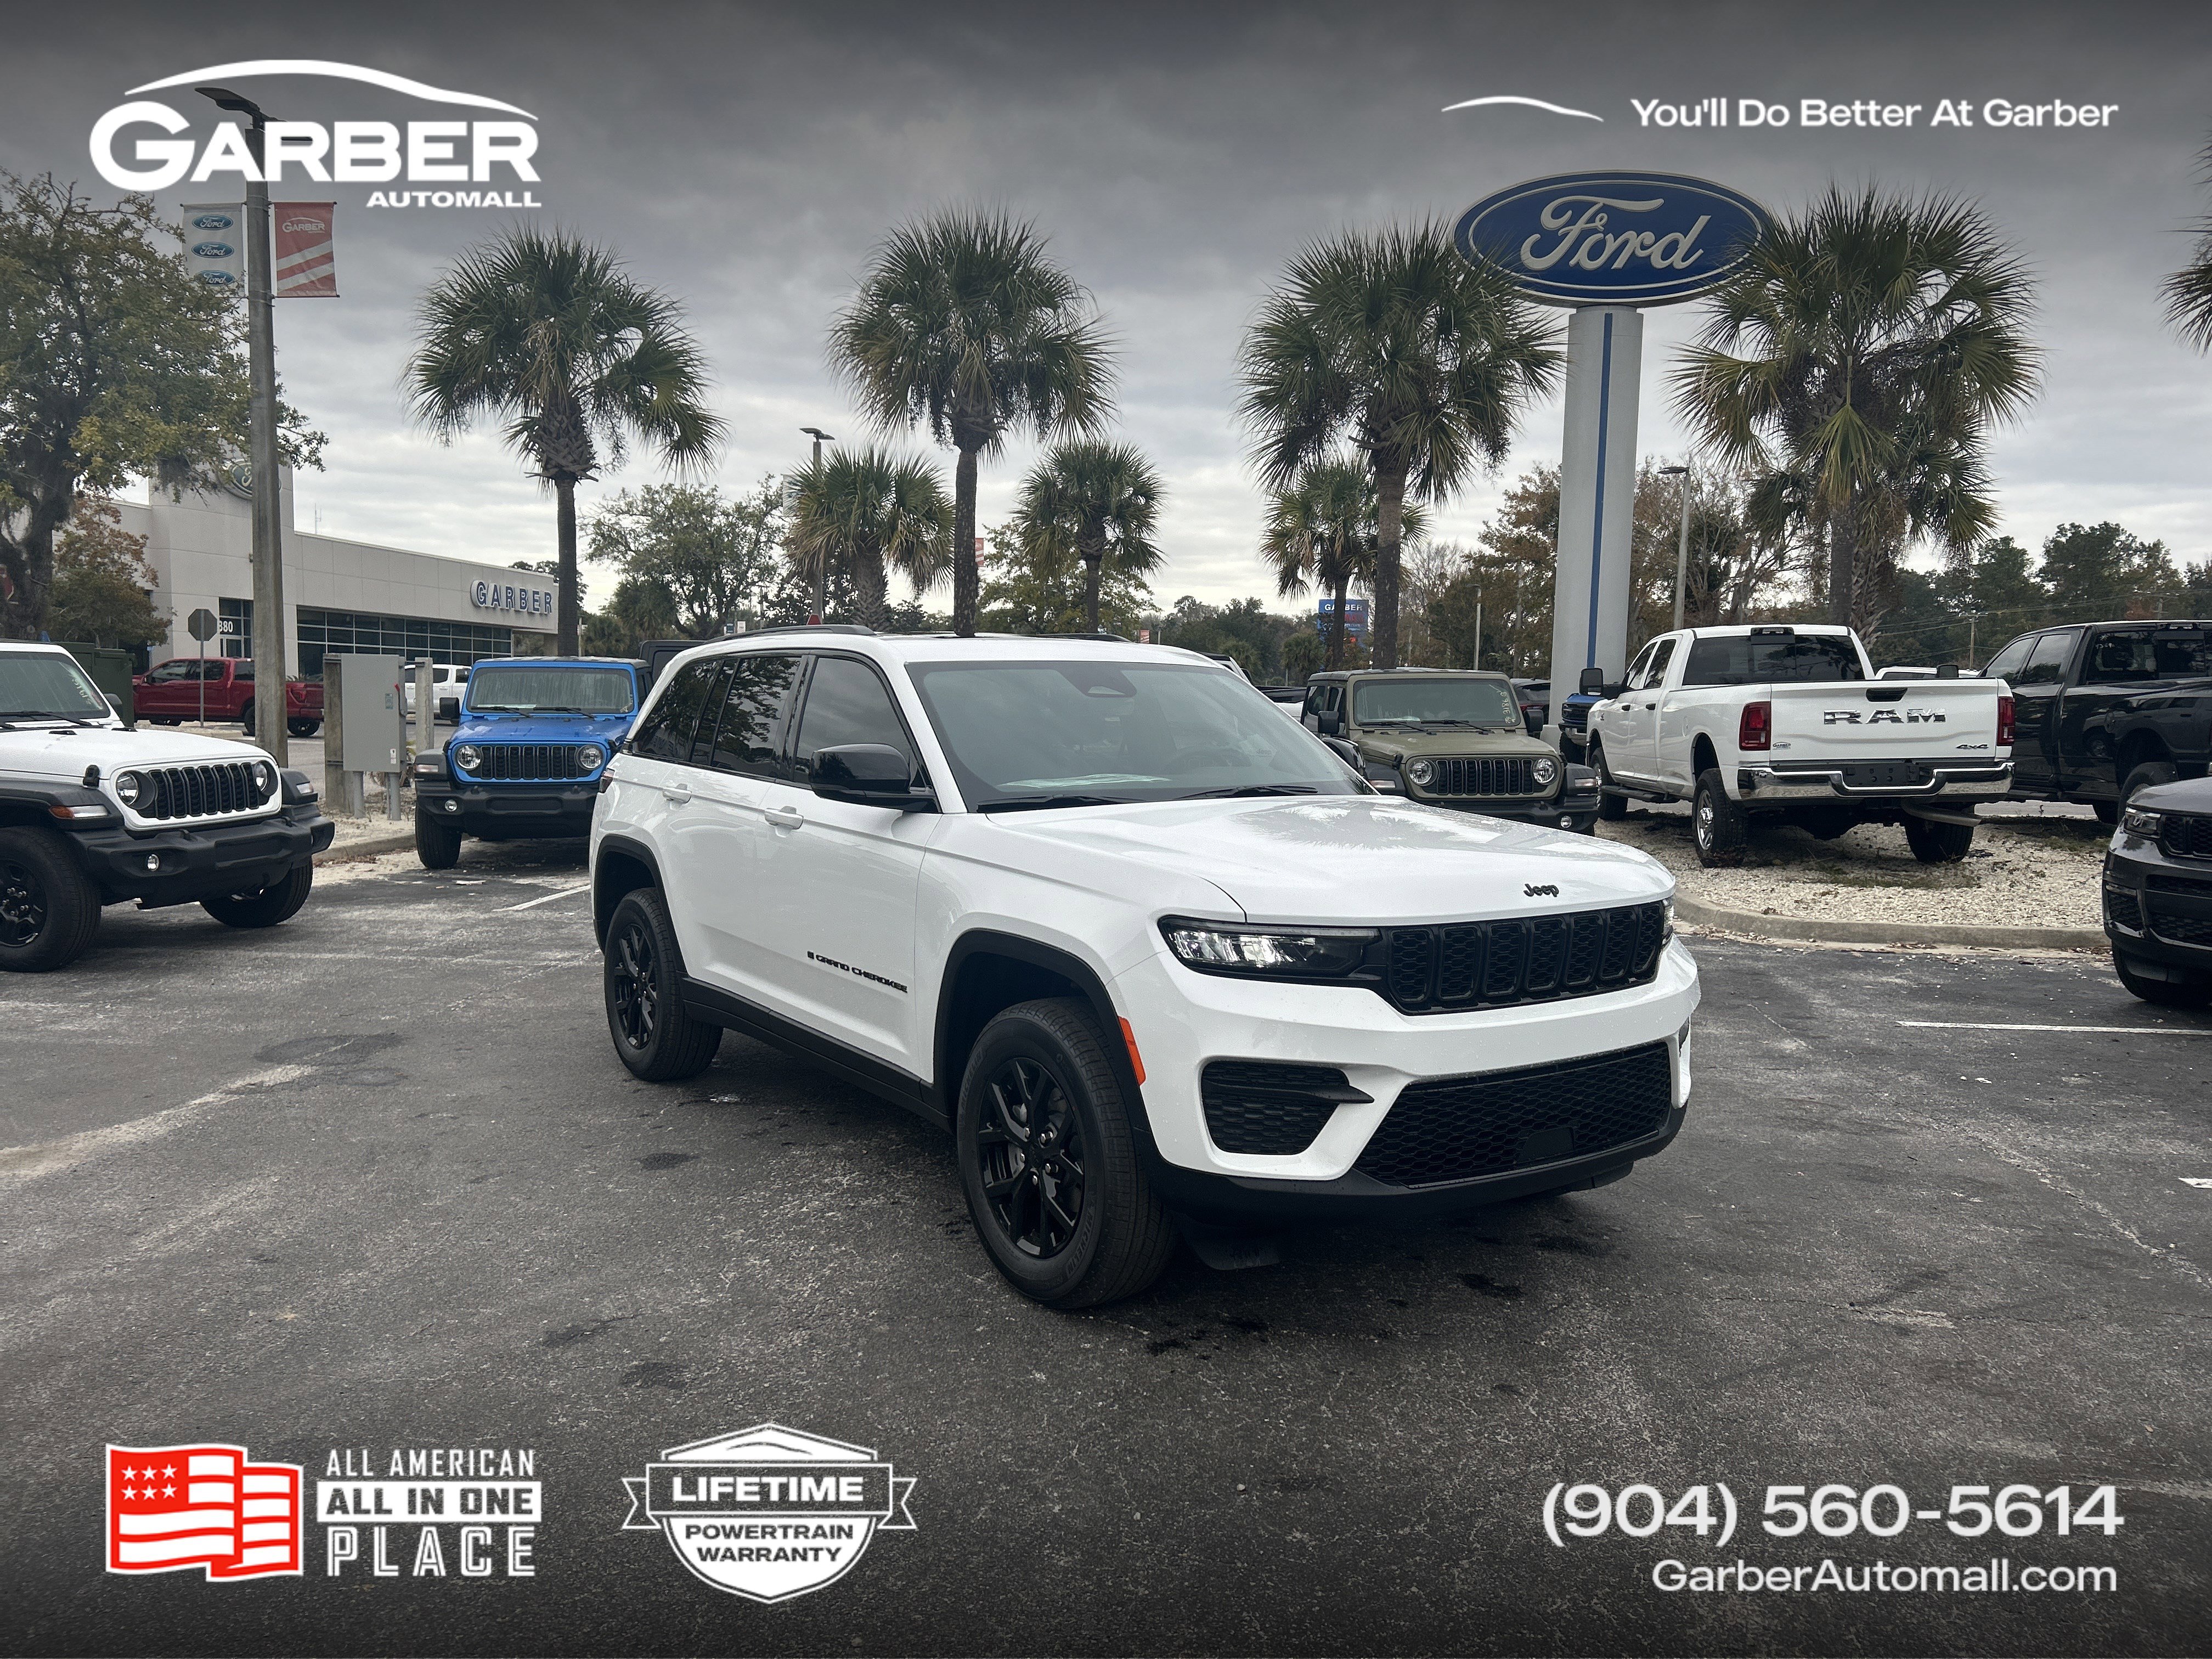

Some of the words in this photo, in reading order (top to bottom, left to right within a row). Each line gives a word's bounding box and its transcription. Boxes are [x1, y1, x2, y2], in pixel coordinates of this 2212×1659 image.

[200, 217, 225, 228] Ford
[282, 222, 325, 233] GARBER
[1520, 195, 1712, 272] Ford
[200, 244, 226, 256] Ford
[471, 580, 552, 614] GARBER
[1823, 708, 1946, 725] RAM
[1523, 883, 1559, 898] Jeep
[816, 955, 850, 972] GRAND
[851, 967, 908, 994] CHEROKEE
